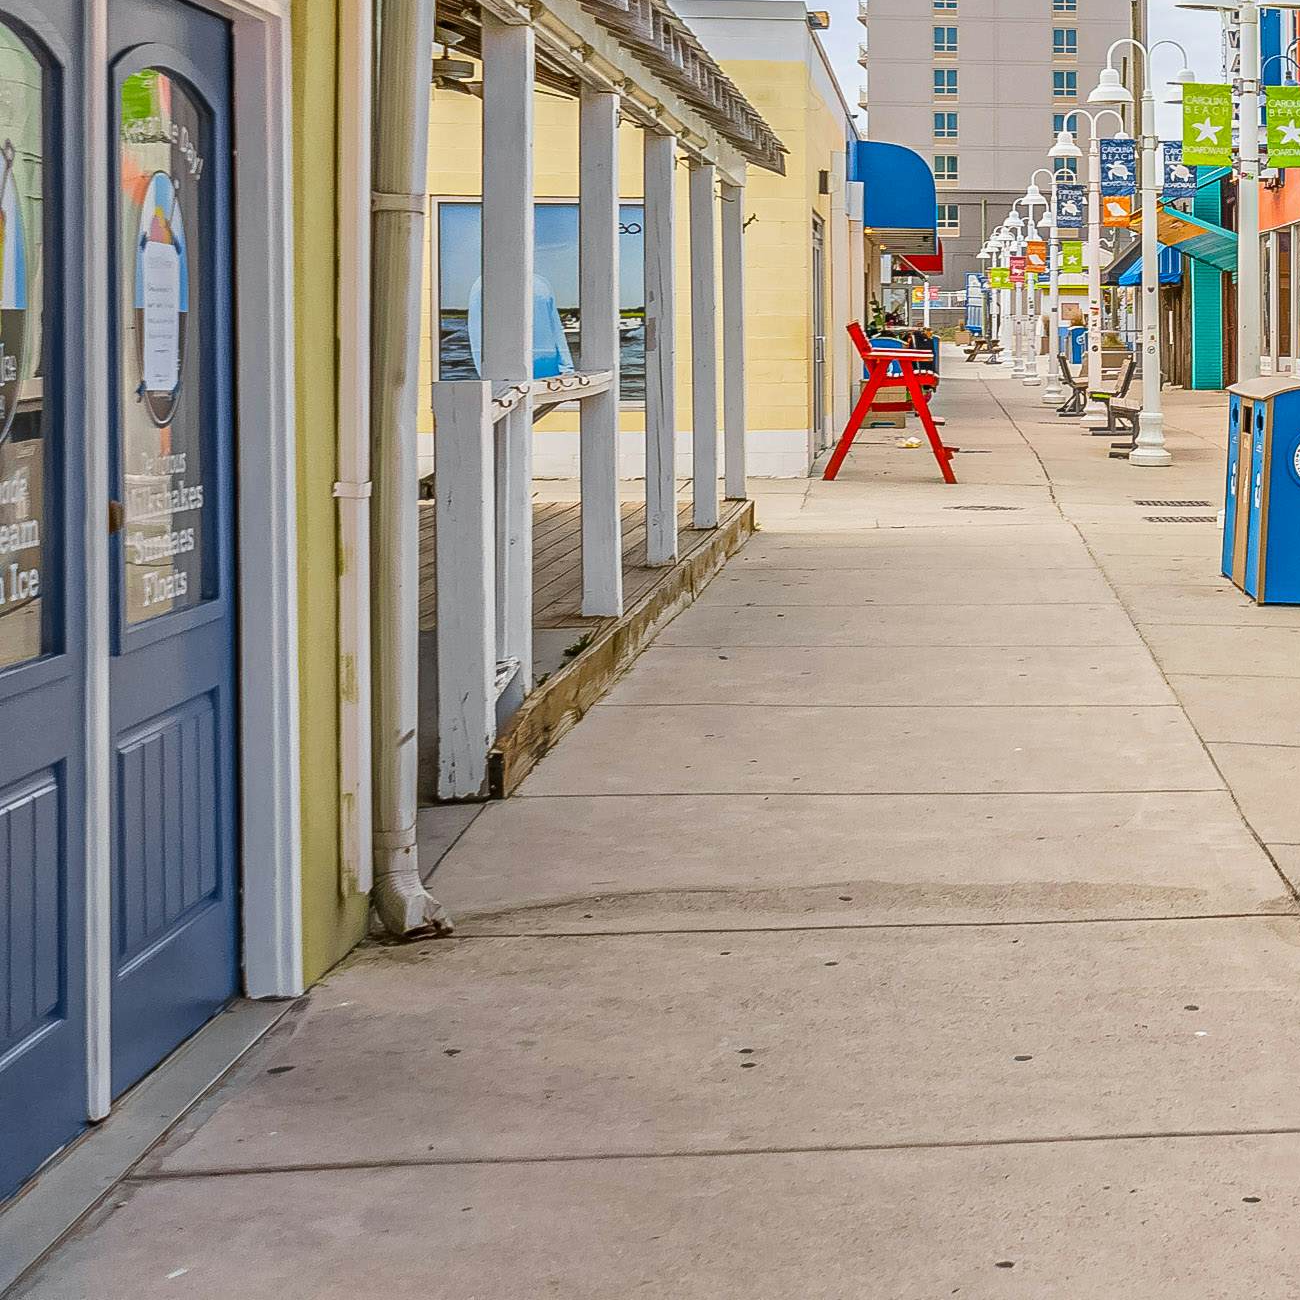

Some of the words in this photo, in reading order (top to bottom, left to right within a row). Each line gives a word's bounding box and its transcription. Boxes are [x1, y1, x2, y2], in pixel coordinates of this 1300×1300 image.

[1184, 95, 1230, 106] CAROLINA
[1184, 105, 1229, 116] BEACH
[1101, 146, 1134, 154] CAROLINA
[1183, 145, 1231, 155] BOARDWALK
